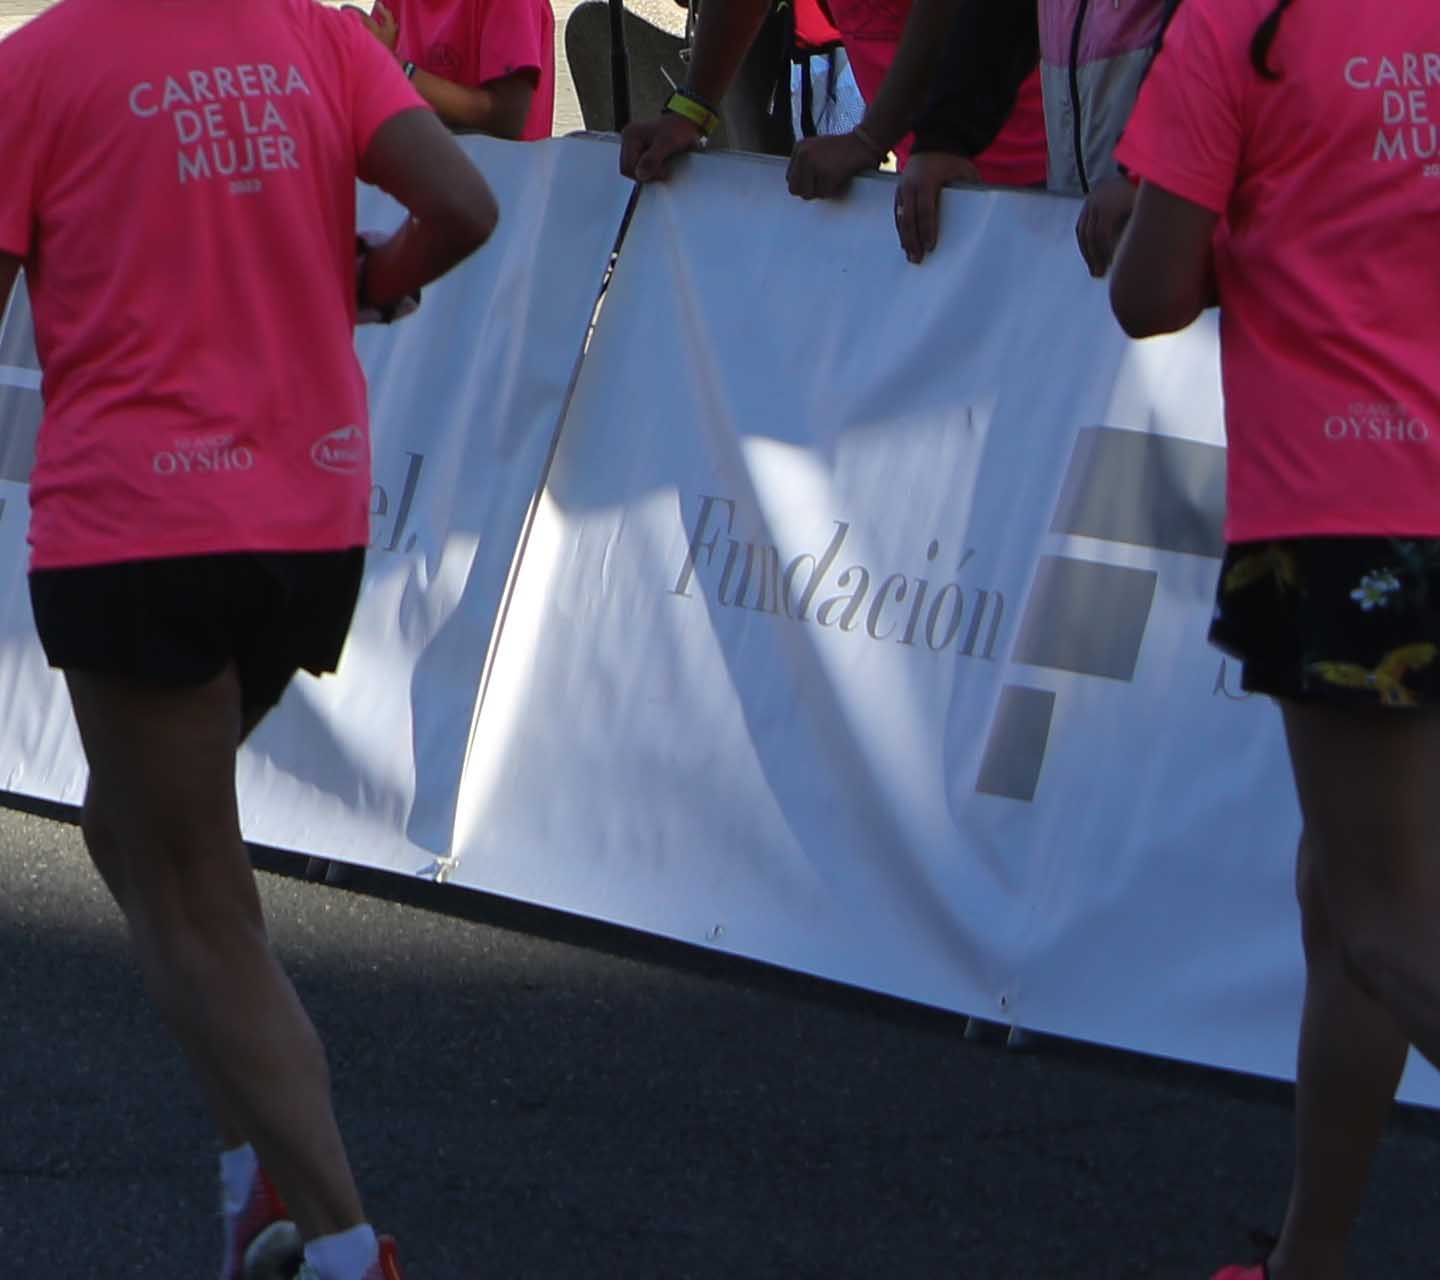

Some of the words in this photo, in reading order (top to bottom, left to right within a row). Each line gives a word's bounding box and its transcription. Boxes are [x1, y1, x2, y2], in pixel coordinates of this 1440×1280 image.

[129, 62, 312, 119] CARRERA
[1382, 90, 1429, 126] DE
[173, 108, 228, 140] DE
[242, 105, 288, 136] LA
[176, 133, 301, 183] MUJER
[1323, 415, 1432, 442] OYSHO
[152, 446, 255, 477] OYSHO
[667, 493, 1008, 661] Fundación
